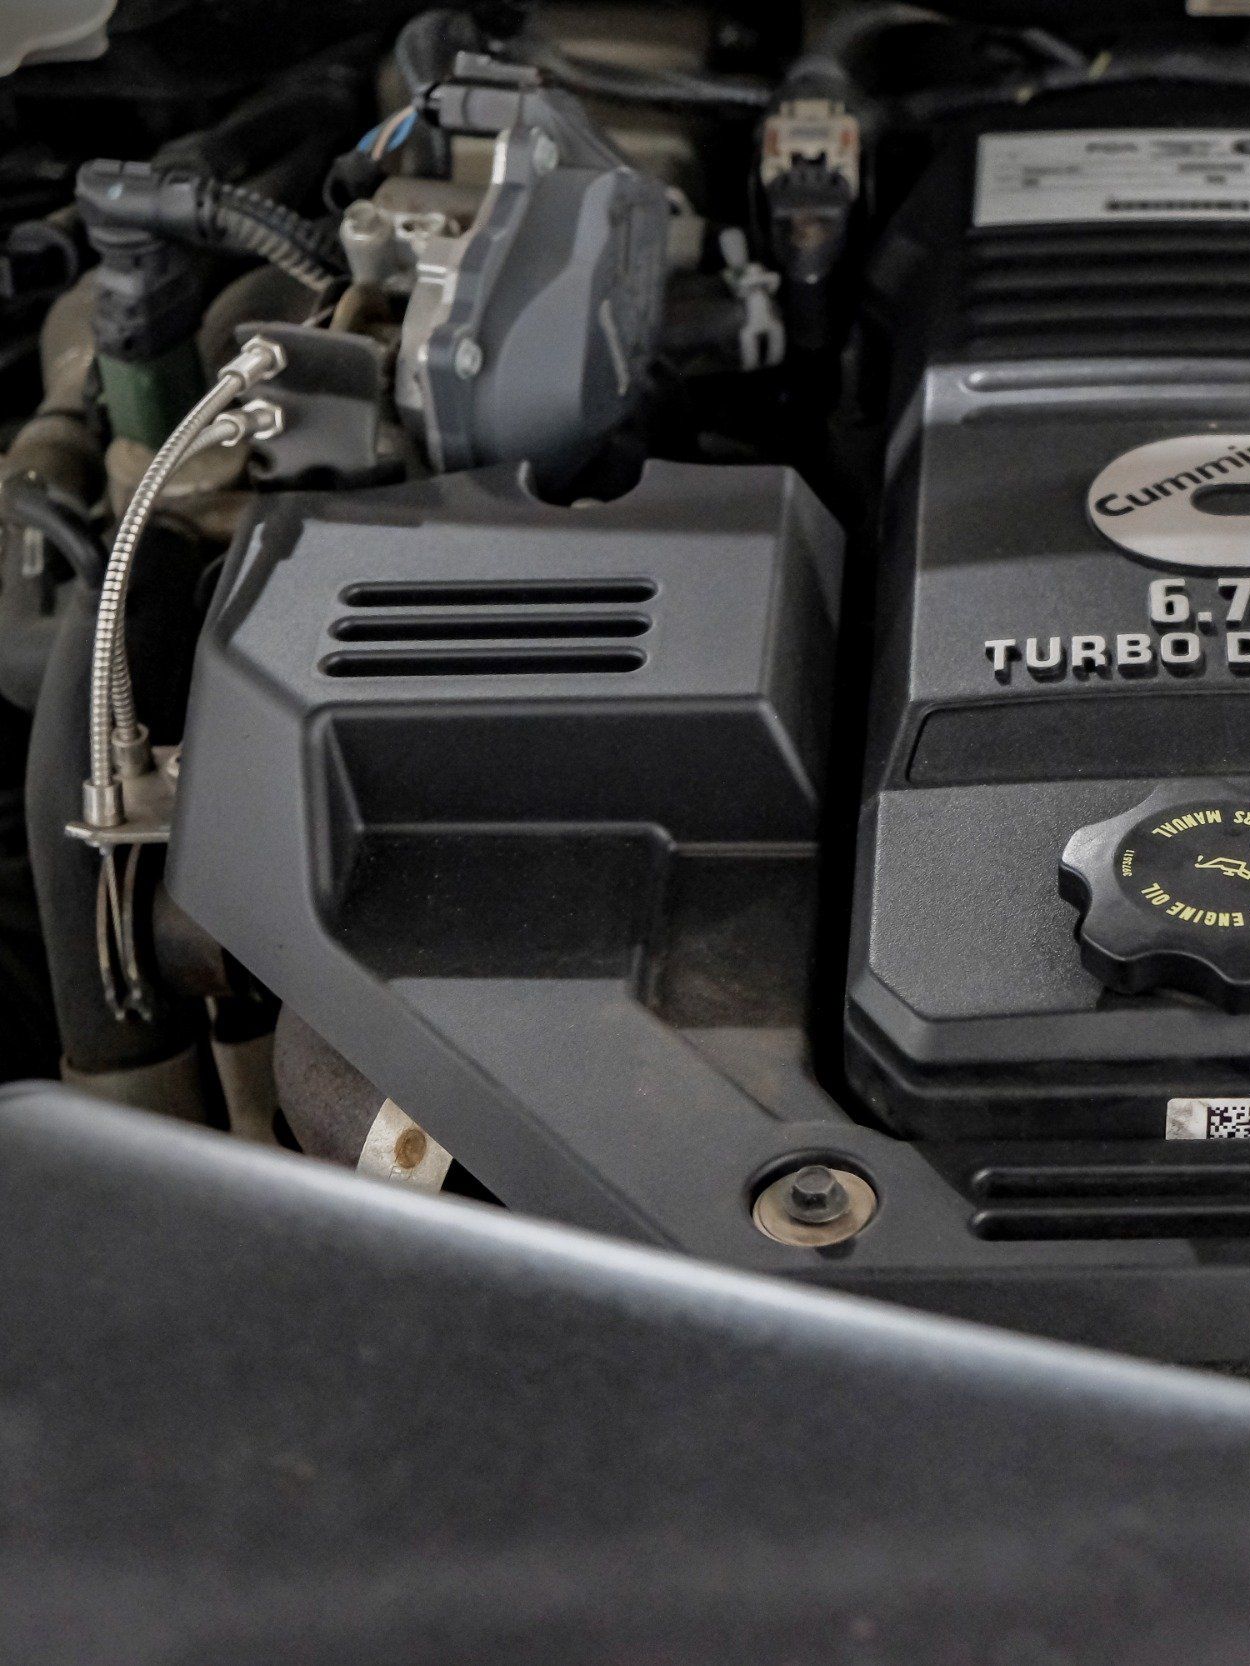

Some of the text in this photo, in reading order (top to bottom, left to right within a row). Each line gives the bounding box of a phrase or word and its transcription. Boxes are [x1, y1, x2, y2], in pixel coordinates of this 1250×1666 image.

[985, 632, 1200, 673] TURBO
[1152, 810, 1222, 838] MANUAL
[1141, 882, 1171, 906] OIL
[1166, 901, 1245, 927] ENGINE
